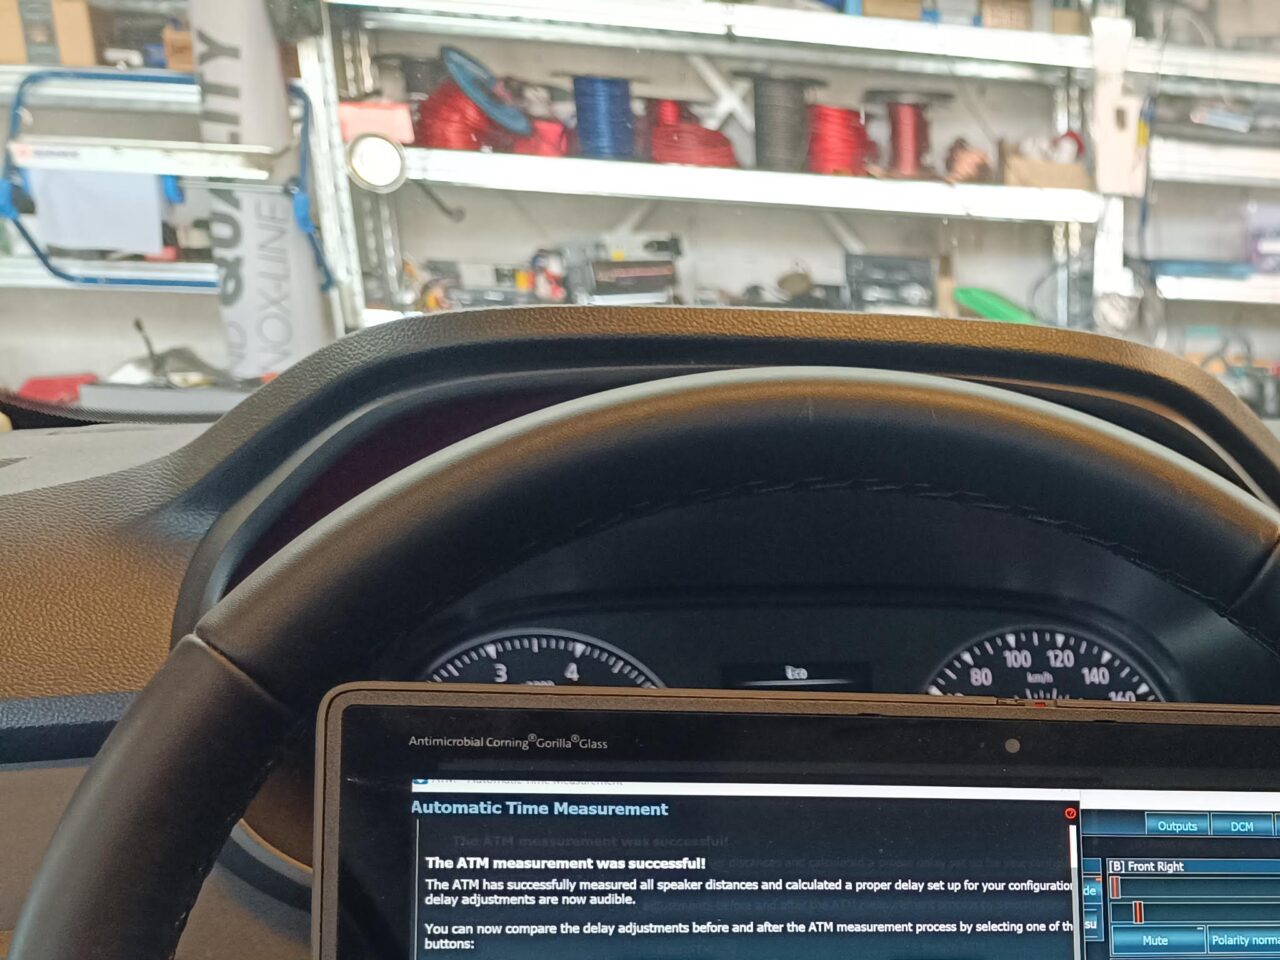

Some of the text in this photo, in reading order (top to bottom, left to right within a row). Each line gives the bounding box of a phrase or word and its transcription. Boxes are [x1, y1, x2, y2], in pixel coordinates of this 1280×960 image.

[1003, 649, 1075, 668] 100 120
[494, 662, 580, 682] 3 4
[970, 667, 1110, 686] 80 140
[1026, 671, 1053, 684] km/h
[408, 736, 484, 747] Antimicrobial
[579, 738, 608, 749] Glass
[411, 800, 669, 817] Automatic Time Measurement
[1158, 821, 1198, 833] Outputs
[1231, 822, 1254, 832] DCM
[426, 857, 706, 870] The ATM measurement was successful!
[1109, 861, 1184, 873] [B] Front Right
[1143, 935, 1168, 946] Mute
[1213, 935, 1250, 947] Polarity
